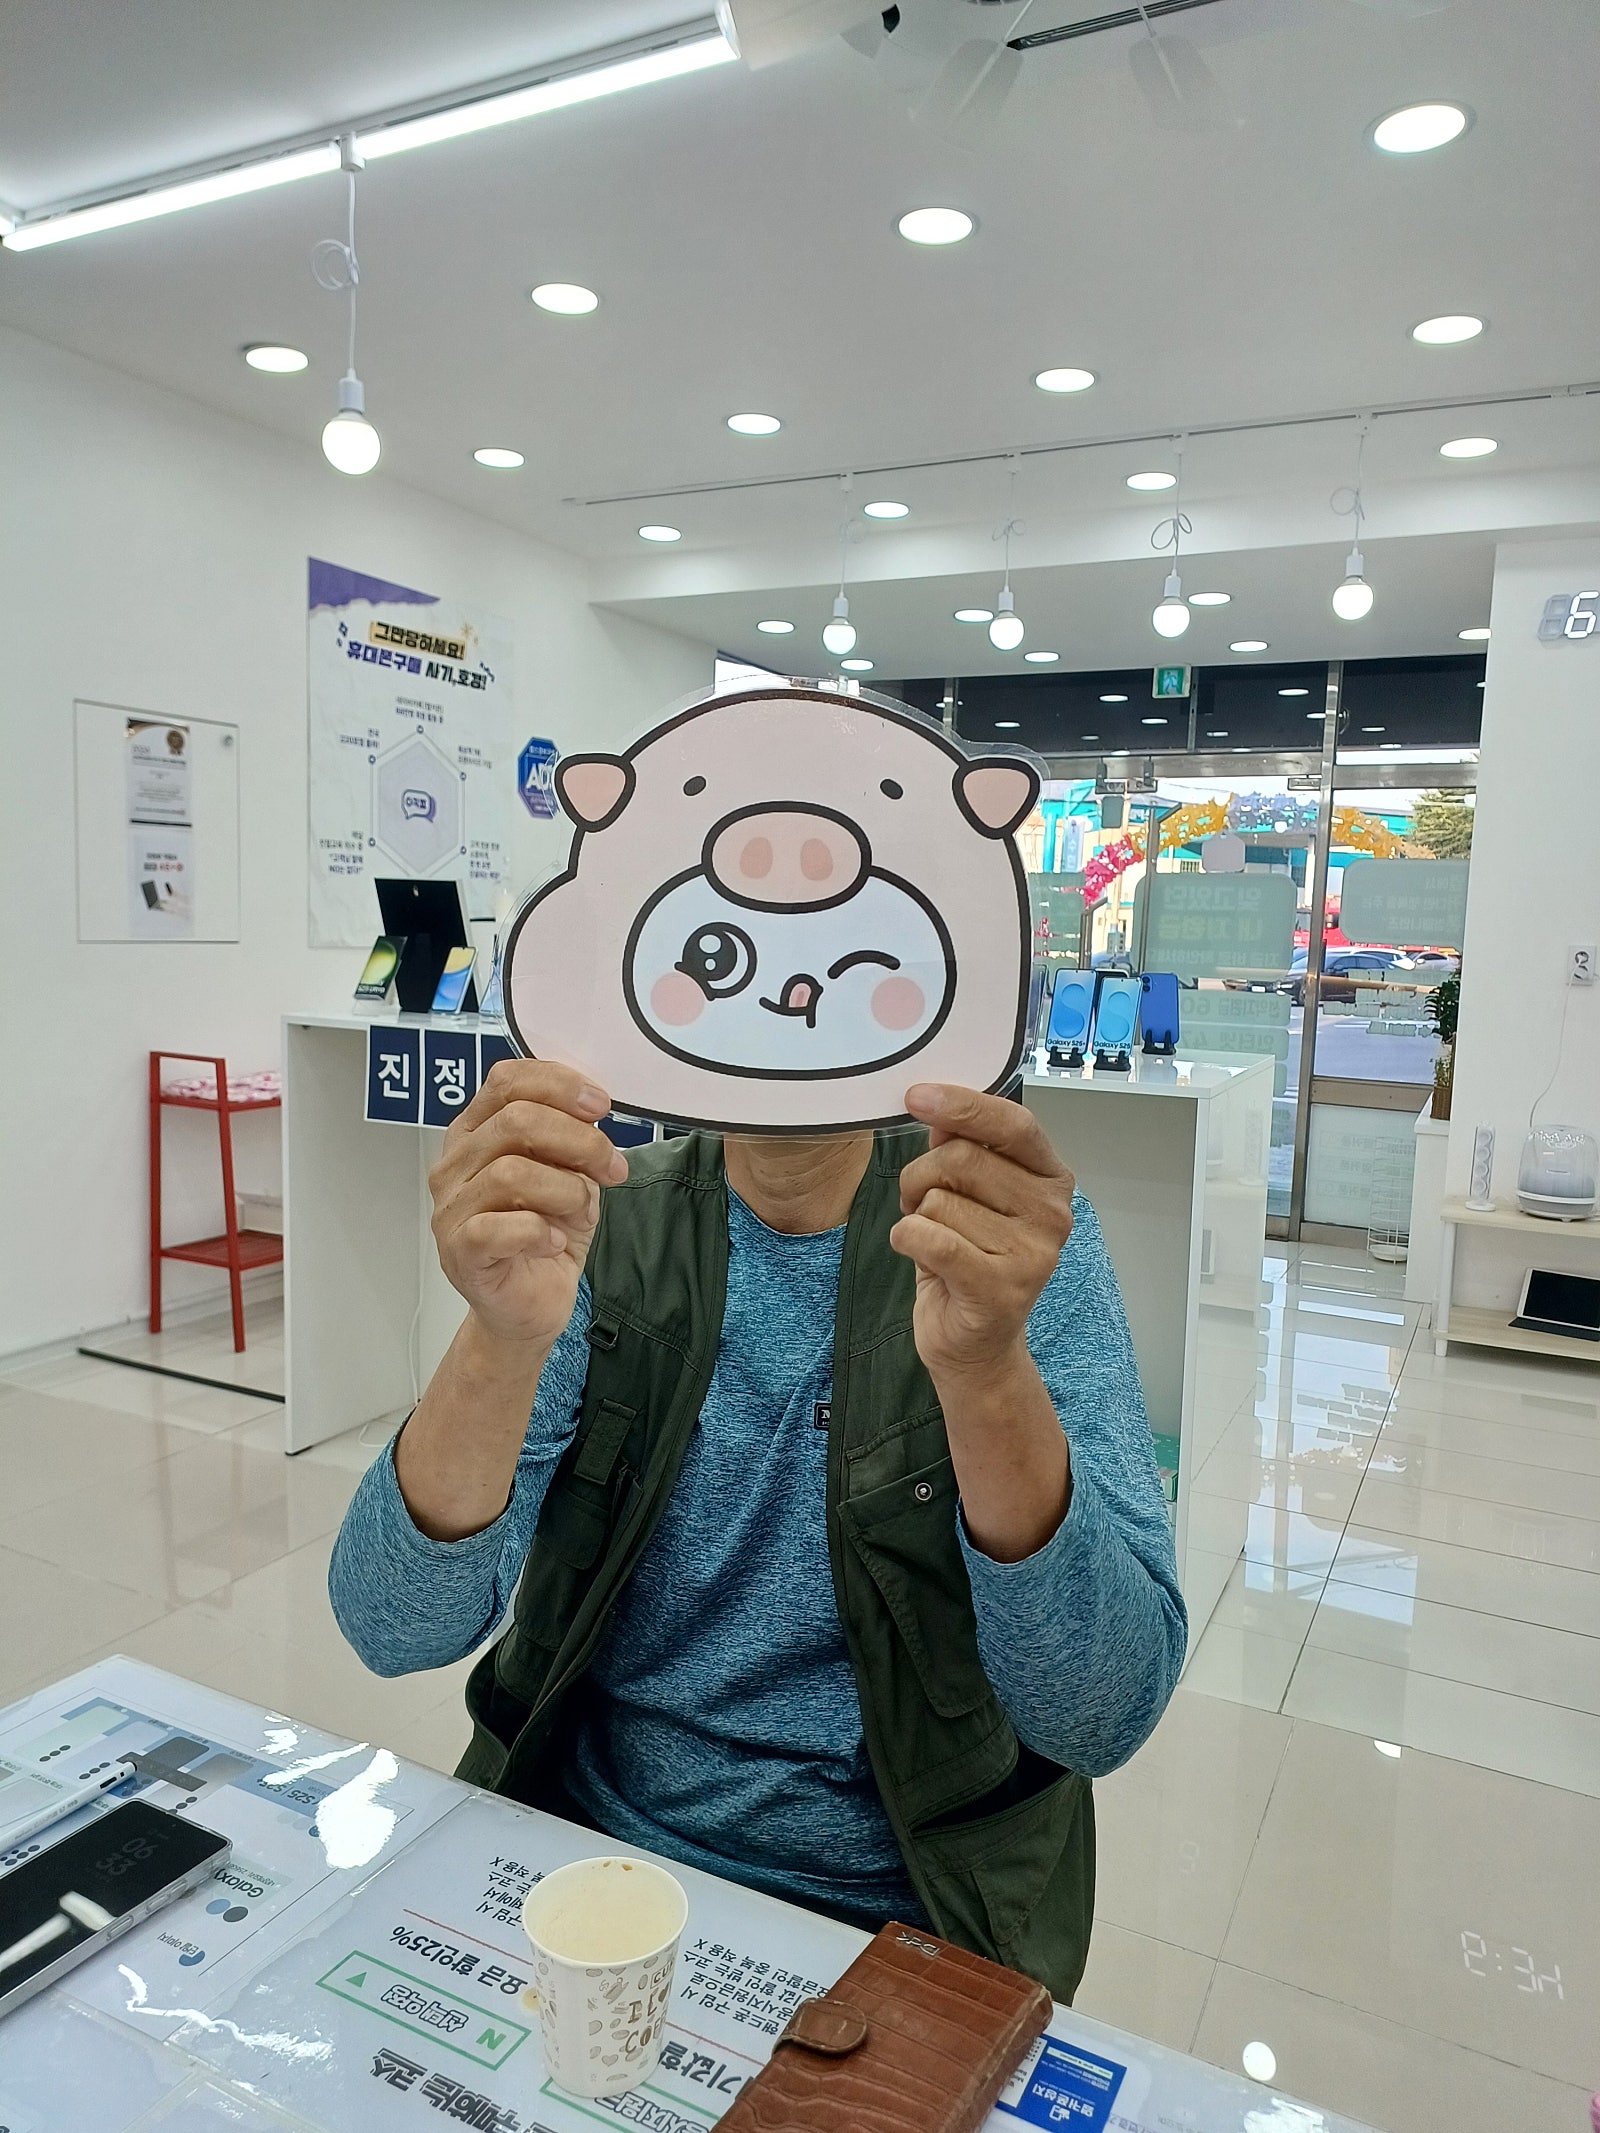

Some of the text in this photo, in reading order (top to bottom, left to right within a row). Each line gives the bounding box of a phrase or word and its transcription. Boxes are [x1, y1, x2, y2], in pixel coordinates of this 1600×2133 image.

[375, 621, 466, 661] 그만당하세요!
[1047, 1038, 1071, 1047] Galaxy
[1093, 1040, 1119, 1050] Galaxy
[489, 1855, 505, 1868] X
[503, 1861, 530, 1879] 적용
[487, 1870, 516, 1888] 코스
[475, 1900, 523, 1929] 구입 시
[694, 1938, 709, 1950] X
[707, 1943, 738, 1963] 적용
[389, 1925, 529, 1995] 요금 할인25%
[683, 1949, 711, 1971] 코스
[737, 1955, 771, 1978] 중복
[712, 1962, 744, 1985] 받는
[679, 1985, 697, 2000] 시
[690, 1971, 795, 2022] 공시지원금으로
[744, 1974, 775, 1998] 할인
[381, 1984, 428, 2015] 약정
[698, 1993, 731, 2014] 구입
[421, 2000, 470, 2032] 선택
[732, 2008, 780, 2036] 핸드폰
[366, 2048, 428, 2094] 코스
